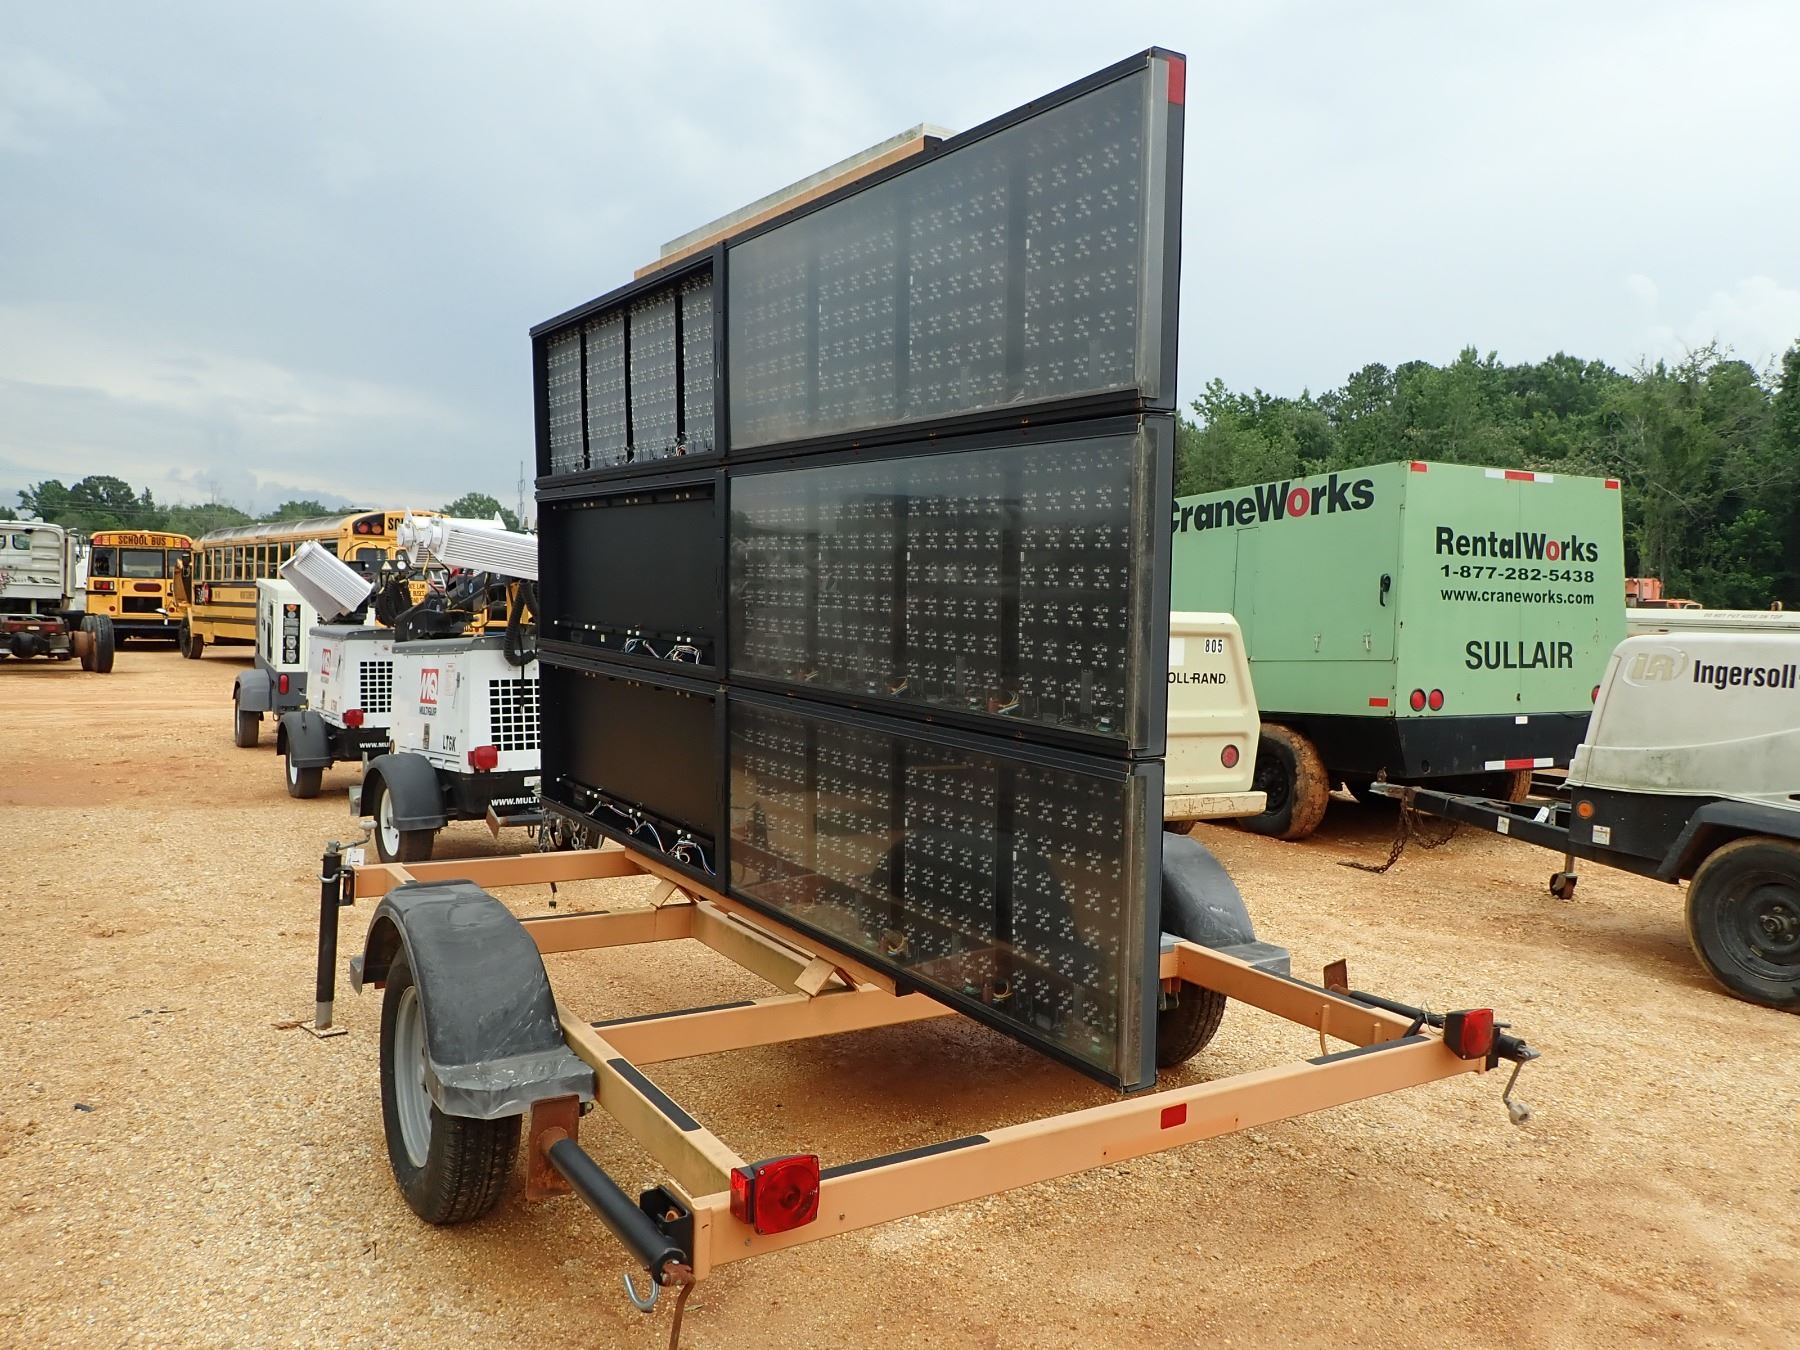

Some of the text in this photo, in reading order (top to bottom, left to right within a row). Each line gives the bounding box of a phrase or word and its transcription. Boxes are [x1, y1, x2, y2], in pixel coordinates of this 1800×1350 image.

[118, 535, 166, 546] SCHOOL BUS
[1436, 526, 1598, 562] RentalWorks
[1441, 564, 1594, 583] 1-877-282-5438
[1441, 589, 1594, 605] www.craneworks.com
[1205, 639, 1223, 653] 805
[1465, 640, 1573, 670] SULLAIR
[1168, 672, 1226, 684] OLL-RAND
[1693, 660, 1800, 690] Ingersoll
[420, 669, 439, 704] MQ
[491, 796, 540, 806] WWW.MULTI
